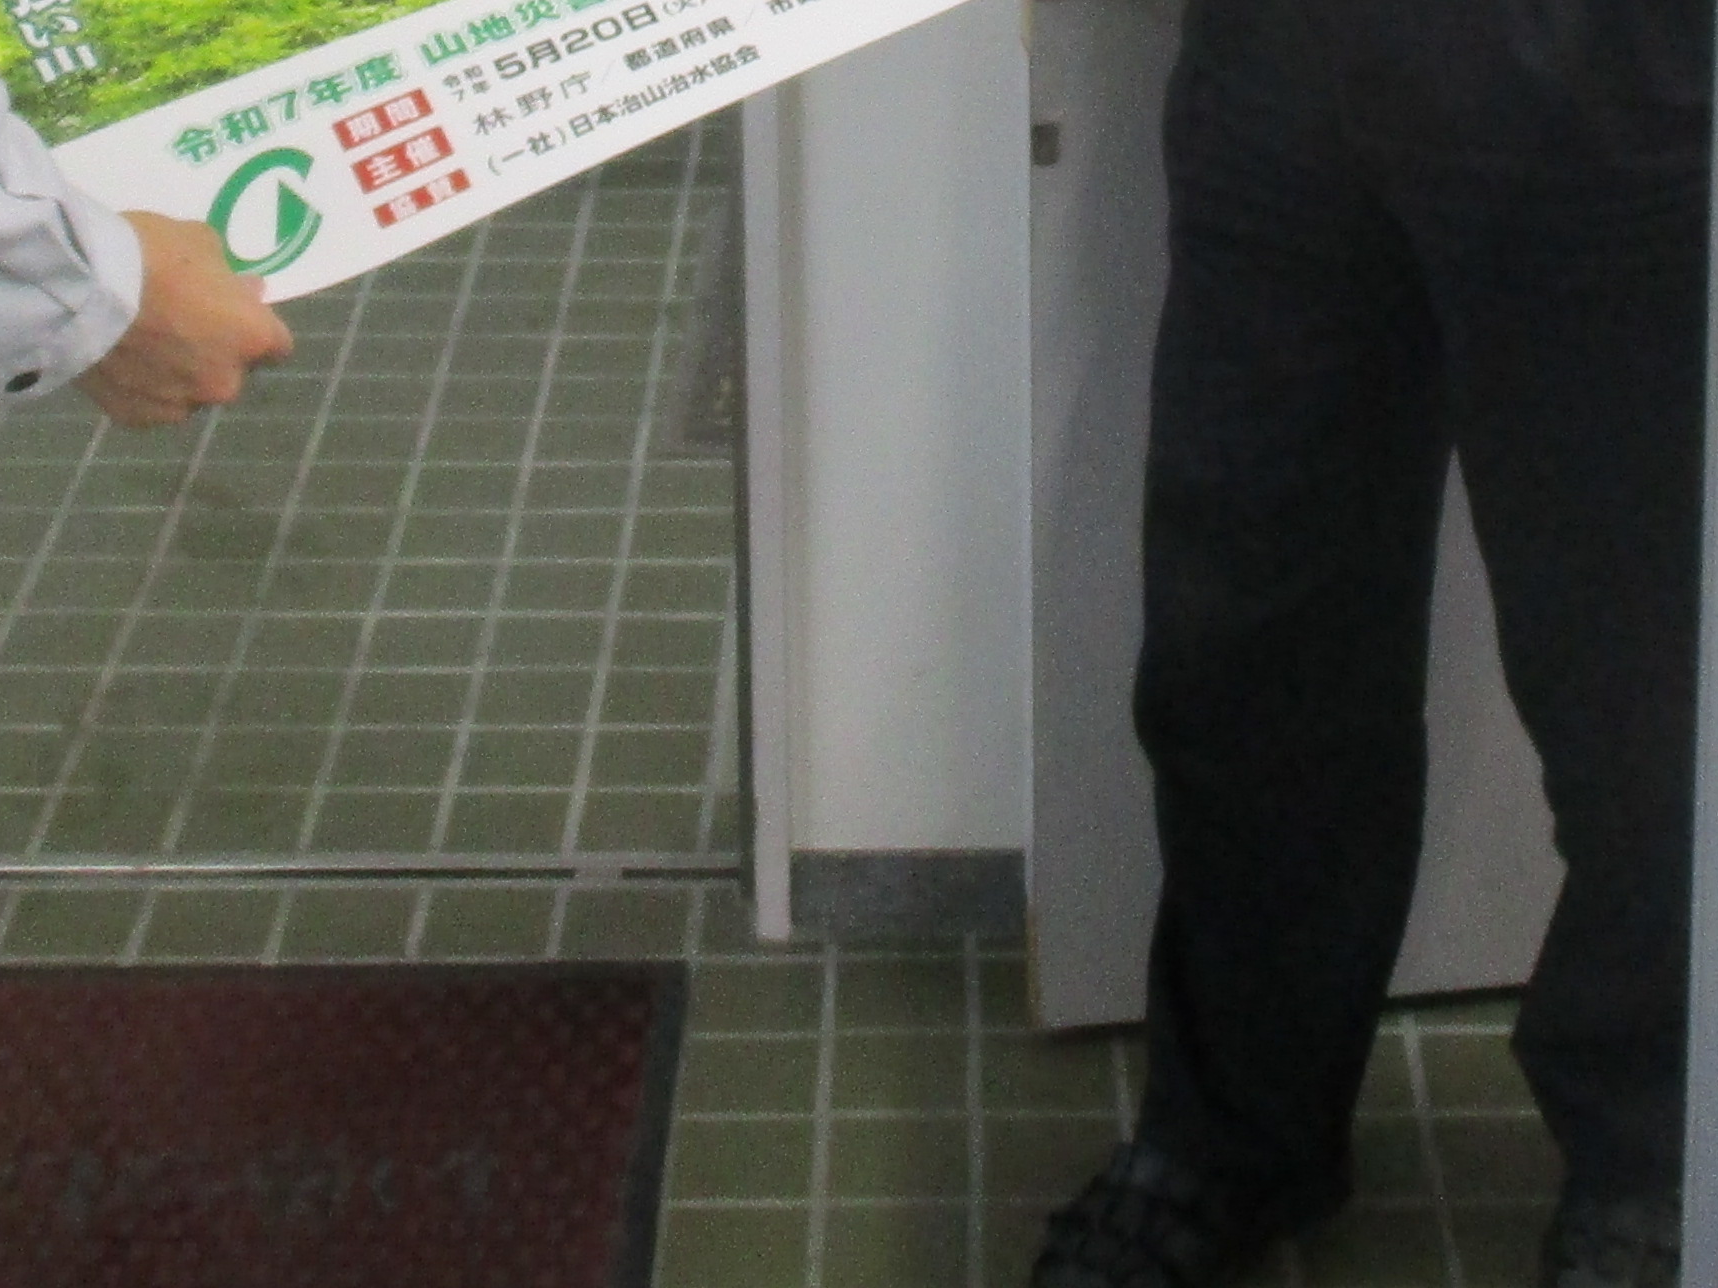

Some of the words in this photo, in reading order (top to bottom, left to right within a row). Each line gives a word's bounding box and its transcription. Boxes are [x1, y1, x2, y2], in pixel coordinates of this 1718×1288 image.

[171, 54, 403, 164] 令和7年度
[474, 72, 592, 136] 林野庁
[624, 16, 736, 73] 都道府県
